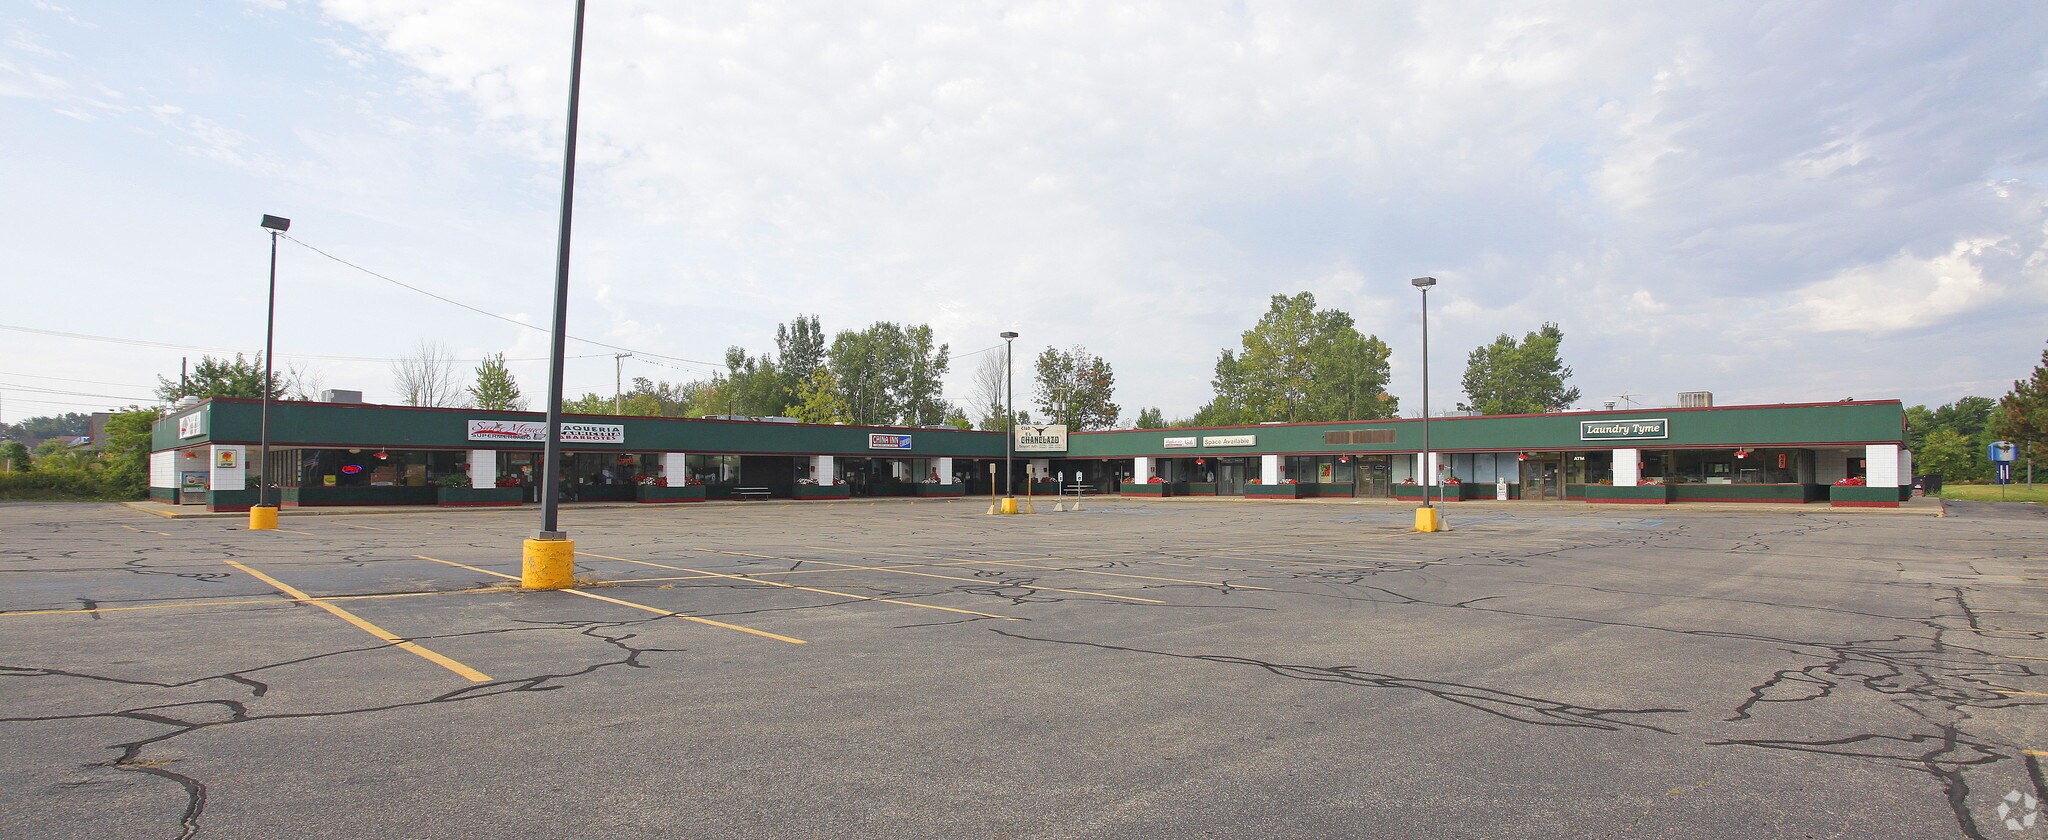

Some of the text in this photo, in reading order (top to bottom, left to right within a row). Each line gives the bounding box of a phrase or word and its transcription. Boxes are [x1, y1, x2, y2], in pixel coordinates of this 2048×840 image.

[1587, 424, 1660, 435] Laundry Tyme
[873, 435, 888, 444] CHINA
[890, 436, 899, 444] INN
[1223, 437, 1249, 445] Available
[341, 465, 360, 473] OPEN
